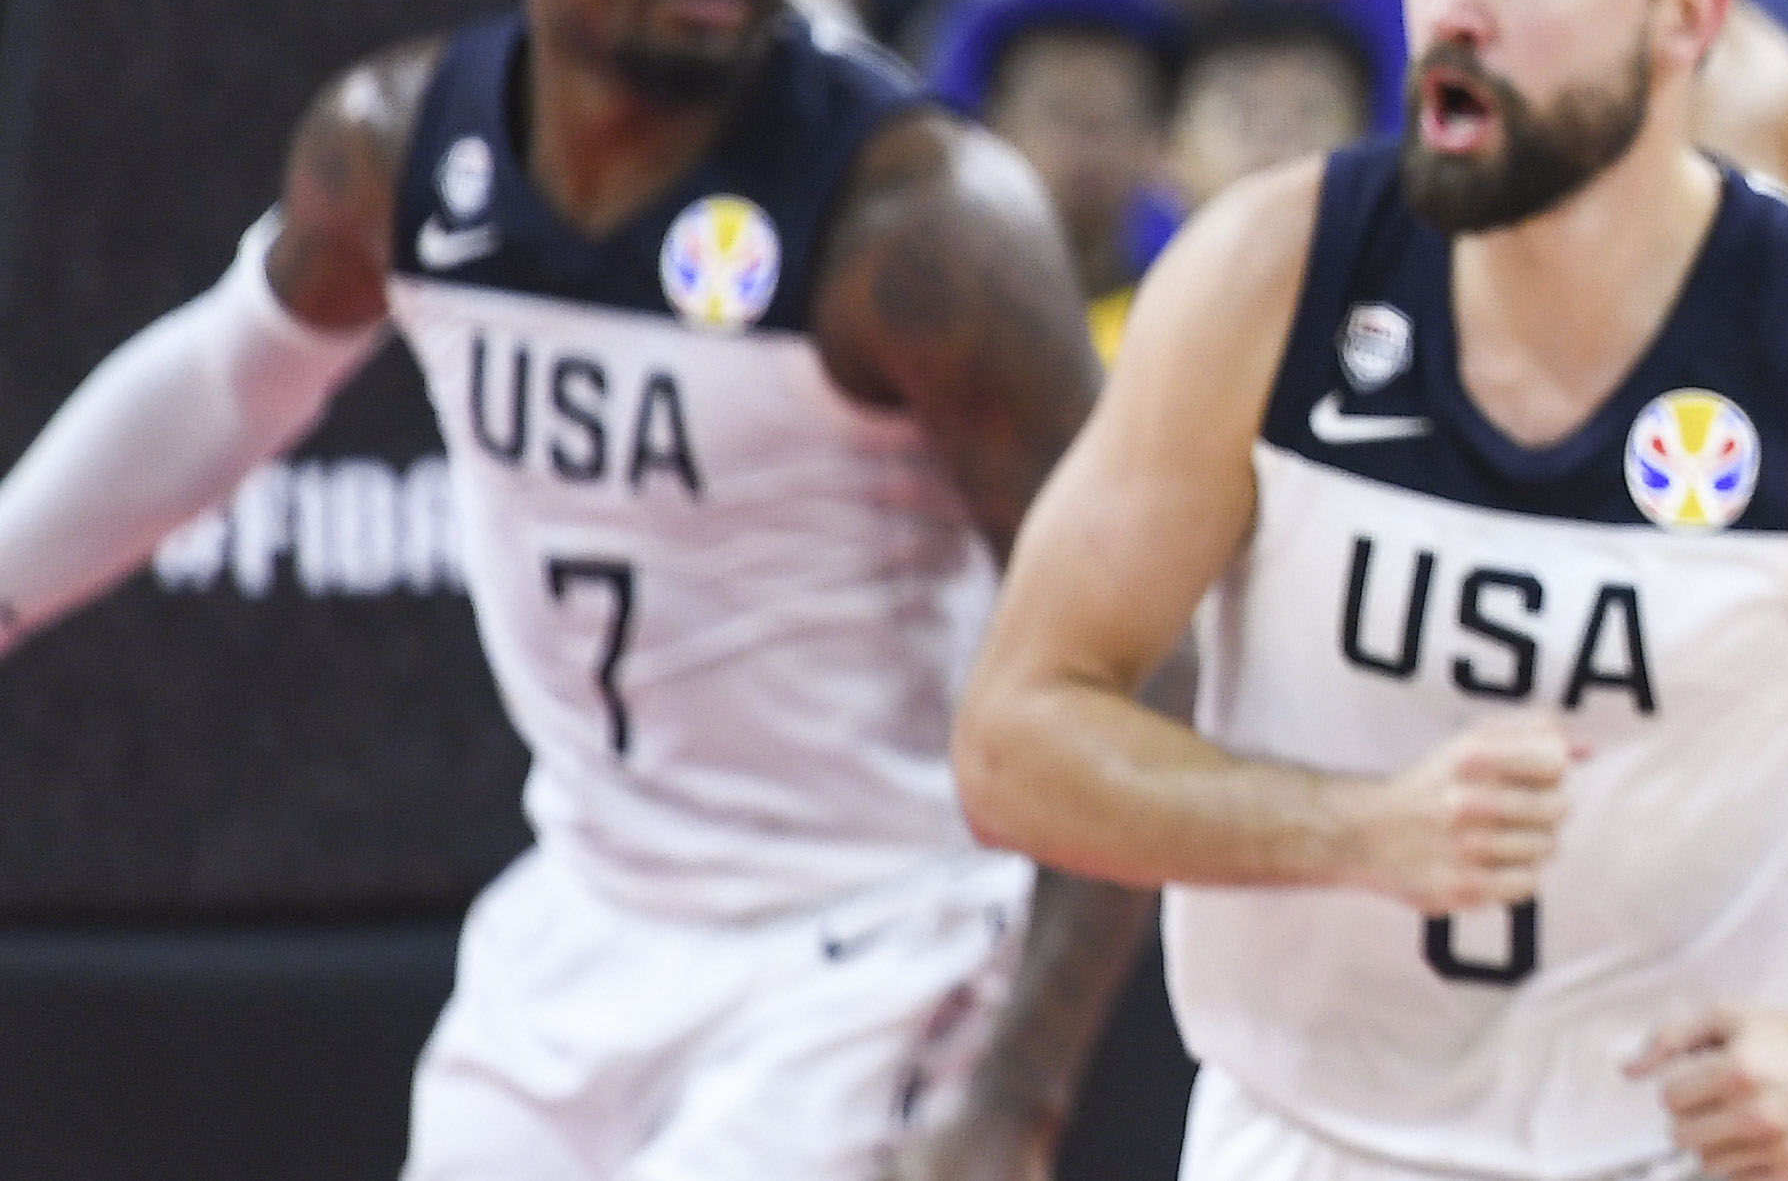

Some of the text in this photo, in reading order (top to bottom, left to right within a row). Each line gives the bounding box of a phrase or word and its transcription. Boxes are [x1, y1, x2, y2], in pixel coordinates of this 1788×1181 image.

[468, 338, 704, 500] USA
[544, 555, 637, 758] 7
[1339, 535, 1658, 716] USA
